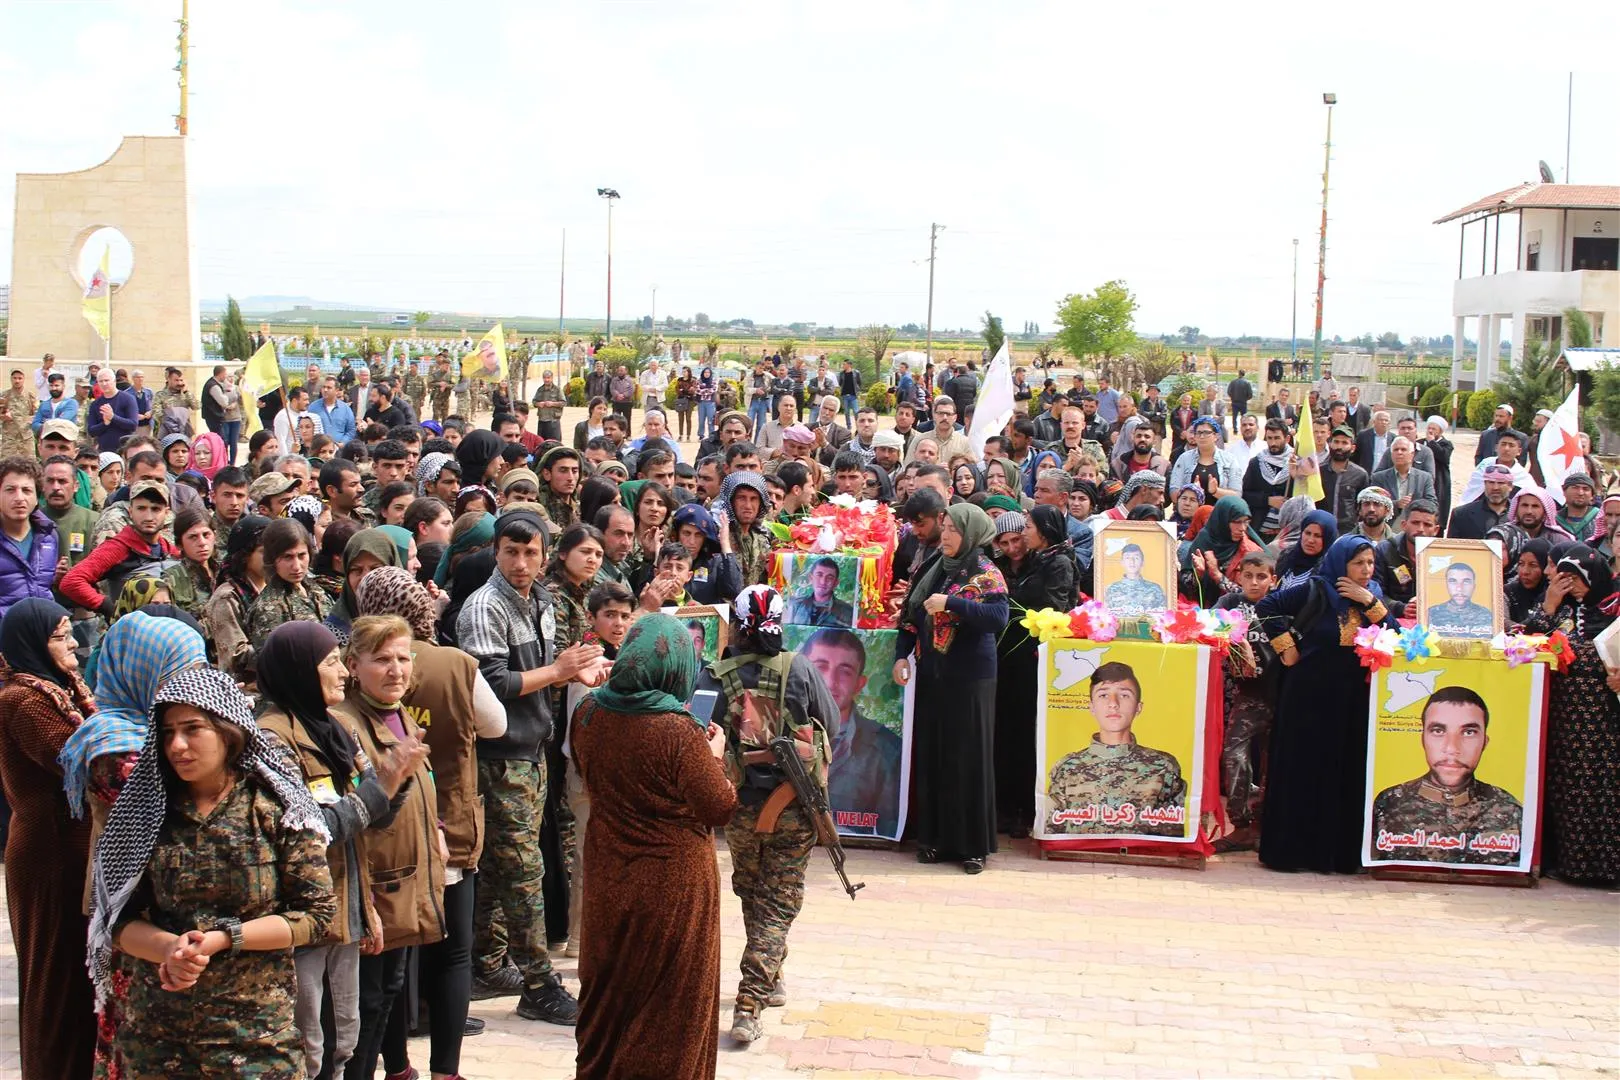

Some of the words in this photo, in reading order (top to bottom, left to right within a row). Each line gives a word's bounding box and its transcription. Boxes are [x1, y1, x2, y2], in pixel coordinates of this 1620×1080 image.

[837, 811, 878, 826] WELAT
[1053, 805, 1098, 825] العيسى
[1102, 802, 1135, 824] زكريا
[1140, 805, 1185, 827] الشهيد
[1377, 829, 1425, 851] الحسين
[1427, 832, 1465, 850] احمد
[1470, 832, 1520, 854] الشهيد
